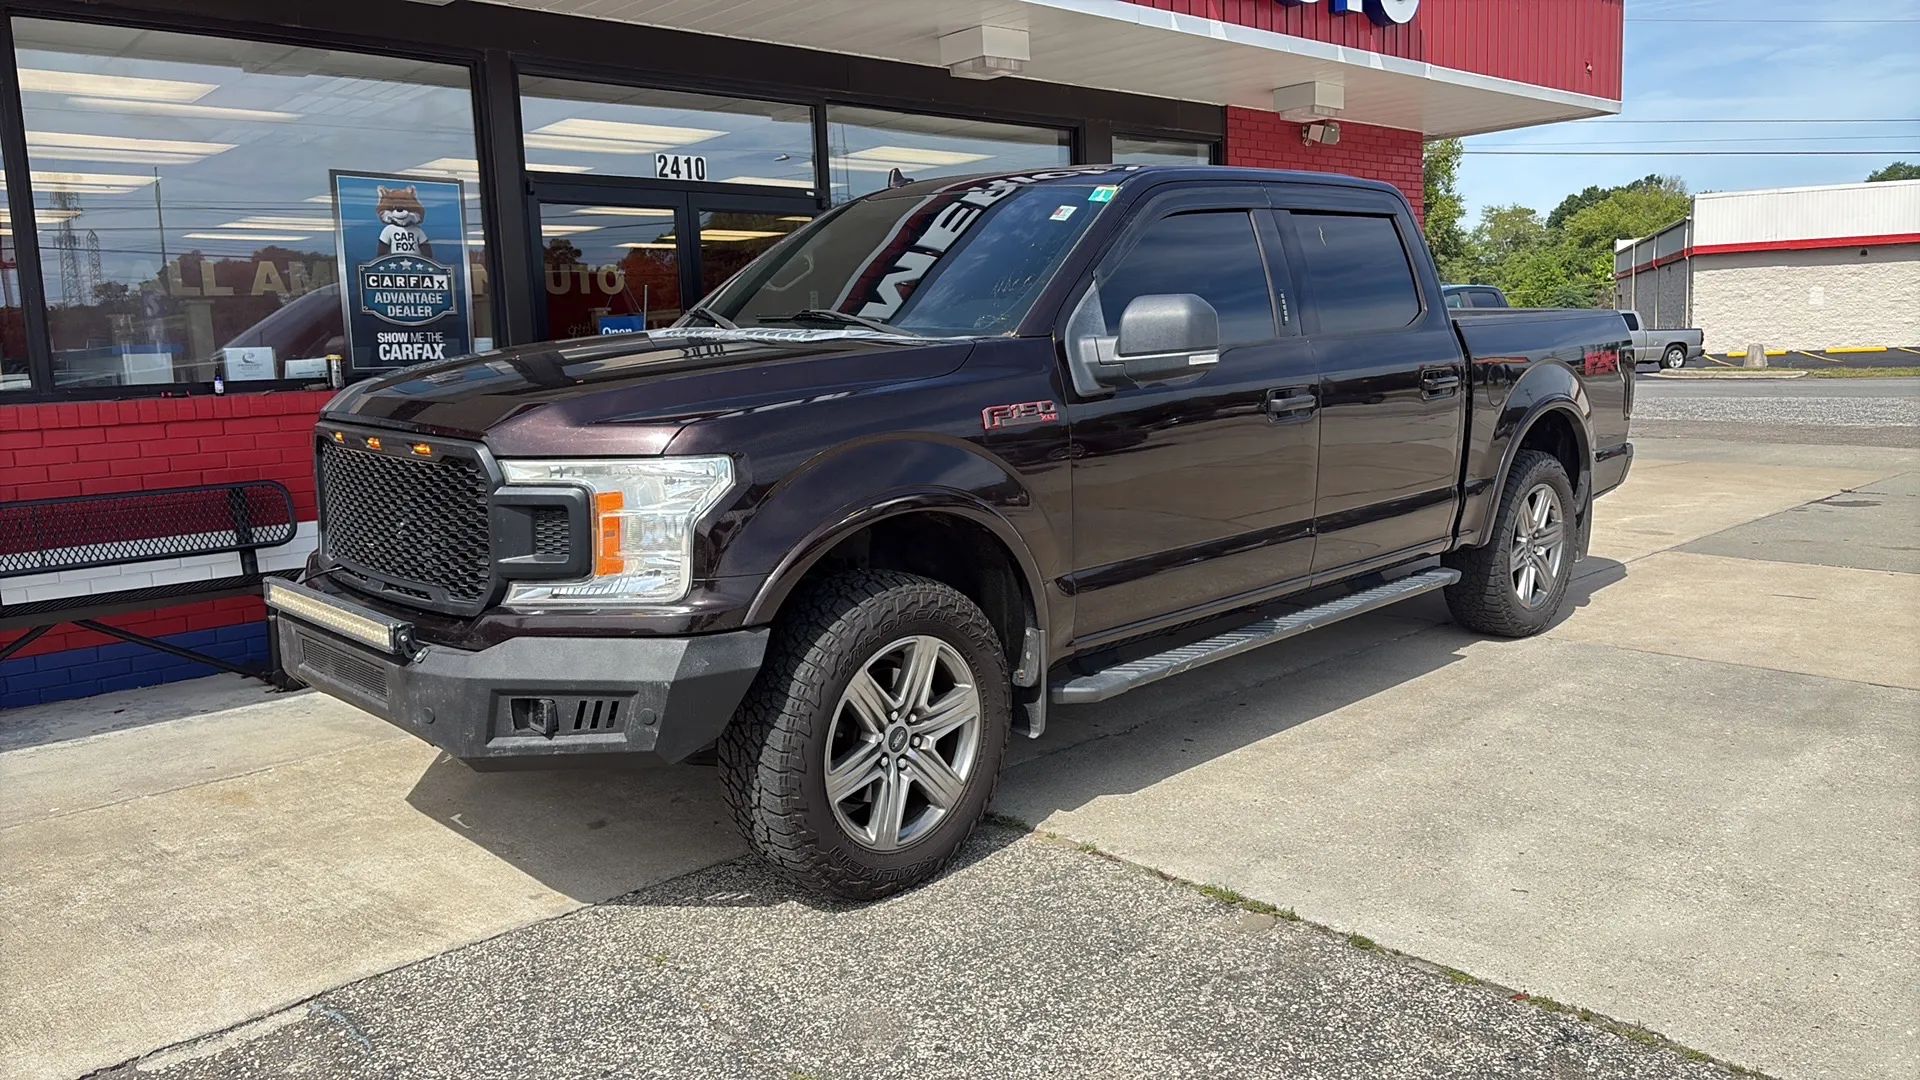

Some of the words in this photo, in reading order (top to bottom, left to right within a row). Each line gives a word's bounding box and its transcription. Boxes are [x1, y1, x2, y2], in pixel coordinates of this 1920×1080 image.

[658, 154, 705, 180] 2410
[393, 231, 415, 242] CAR
[395, 242, 415, 252] FOX
[368, 275, 448, 290] CARFAX
[544, 263, 625, 295] UTO
[374, 292, 443, 304] ADVANTAGE
[387, 305, 432, 317] DEALER
[377, 332, 408, 343] SHOW
[410, 332, 425, 343] ME
[426, 332, 444, 343] THE
[378, 343, 446, 361] CARFAX
[1040, 413, 1057, 424] XLT
